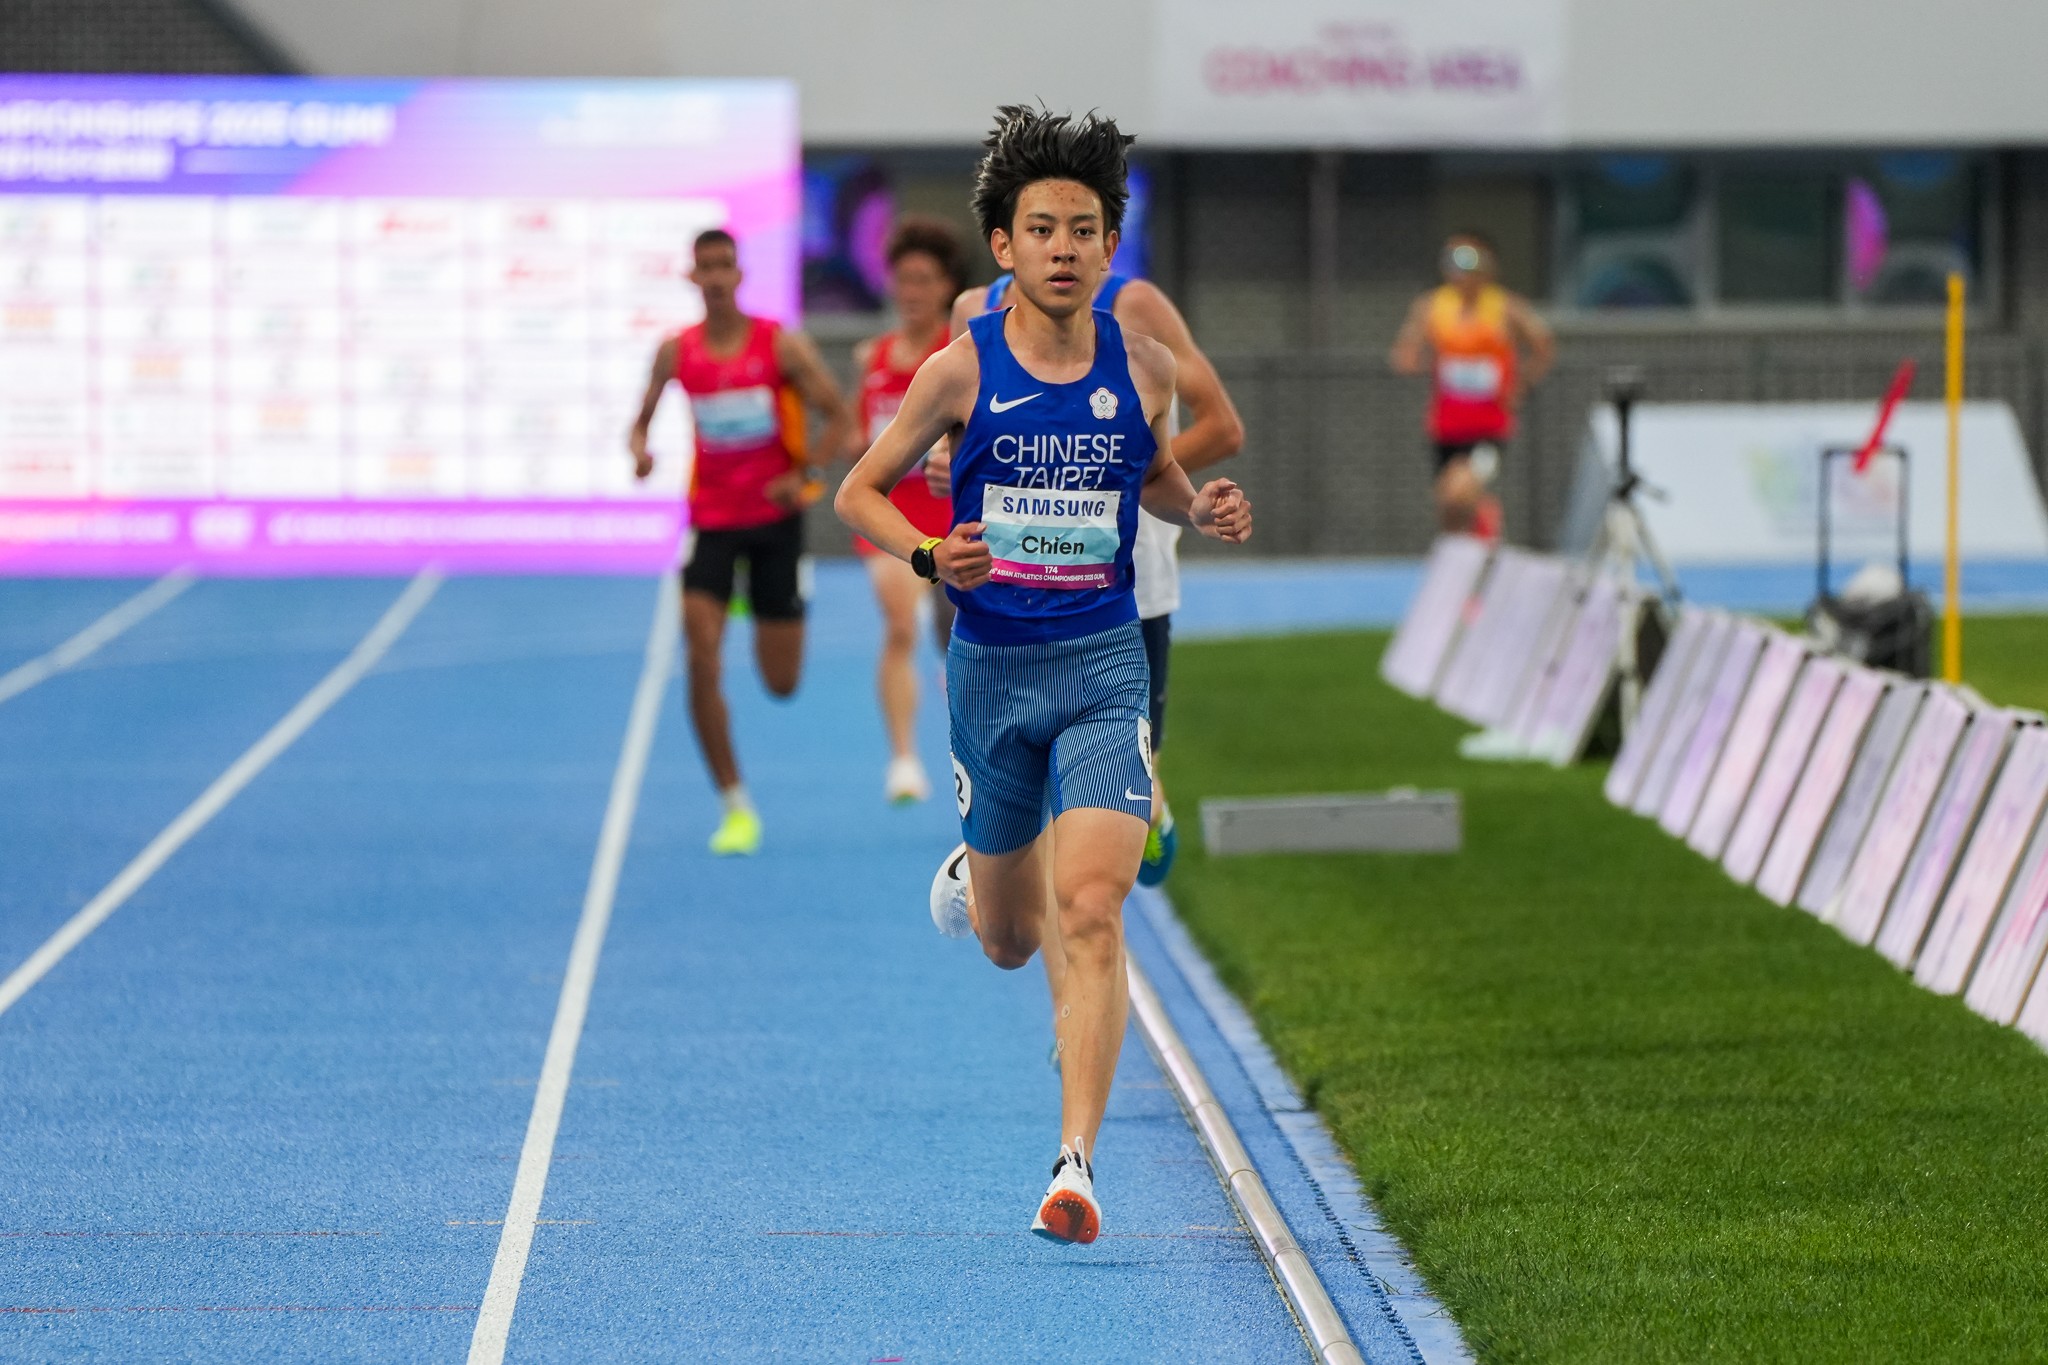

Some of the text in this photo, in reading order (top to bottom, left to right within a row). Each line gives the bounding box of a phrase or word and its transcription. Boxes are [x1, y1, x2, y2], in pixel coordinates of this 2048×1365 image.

[992, 434, 1125, 464] CHINESE
[1013, 466, 1105, 492] TAIPEI
[1002, 496, 1106, 517] SAMSUNG
[1021, 535, 1085, 555] Chien
[997, 569, 1014, 578] ASIAN
[1013, 572, 1043, 580] ATHLETICS
[1043, 574, 1084, 582] CHAMPIONSHIPS
[1044, 566, 1058, 574] 174
